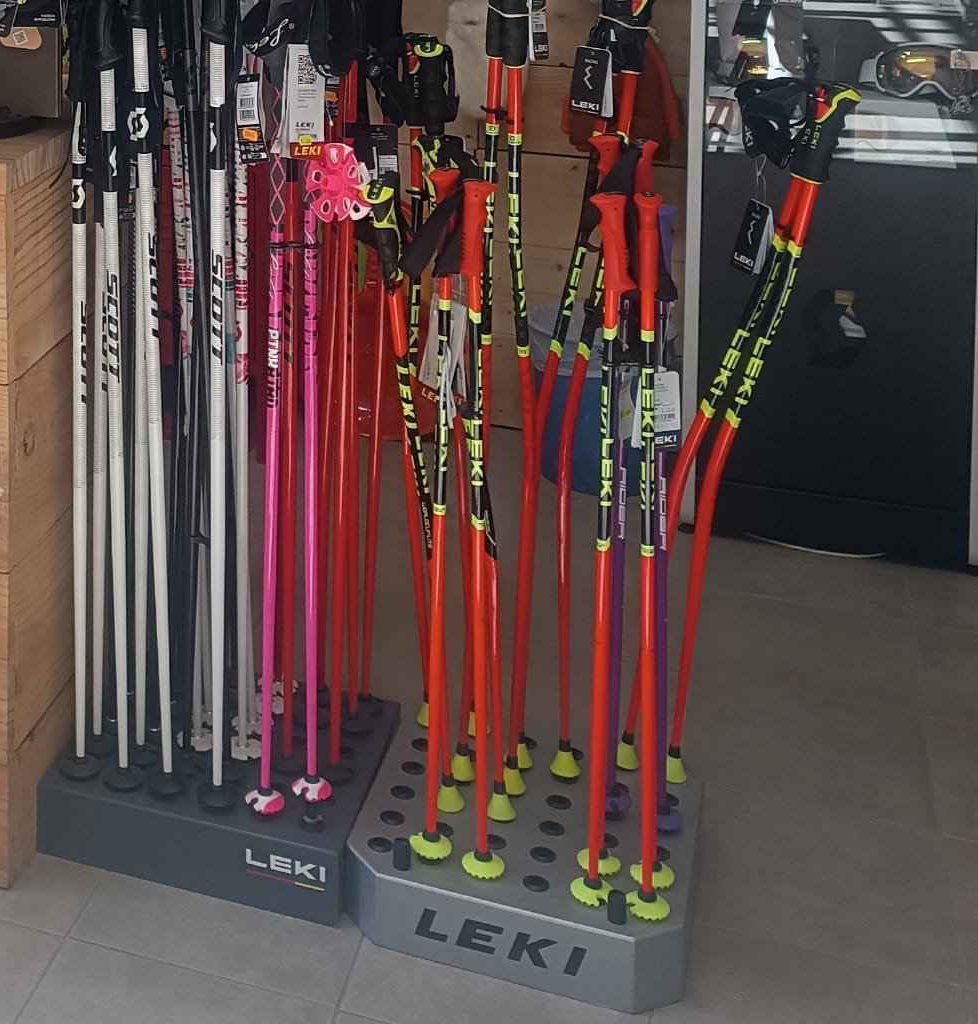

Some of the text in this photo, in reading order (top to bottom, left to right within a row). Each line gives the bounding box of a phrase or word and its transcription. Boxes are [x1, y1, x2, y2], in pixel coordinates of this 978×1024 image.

[572, 99, 599, 111] LEKI
[810, 125, 822, 150] LEKI
[294, 145, 322, 157] LEKI
[562, 246, 587, 317] LEKI
[734, 251, 754, 266] LEKI
[106, 269, 120, 383] SCOTT
[212, 248, 223, 366] SCOTT
[409, 285, 421, 355] LEKI
[396, 364, 418, 430] LEKI
[710, 329, 751, 397] LEKI
[734, 336, 772, 406] LEKI
[640, 368, 655, 438] LEKI
[471, 419, 484, 487] LEKI
[599, 439, 614, 507] LEKI
[655, 435, 677, 444] EKI
[618, 466, 627, 540] RIDER
[659, 476, 667, 551] RIDER
[246, 848, 326, 883] LEKI
[415, 908, 588, 976] LEKI
